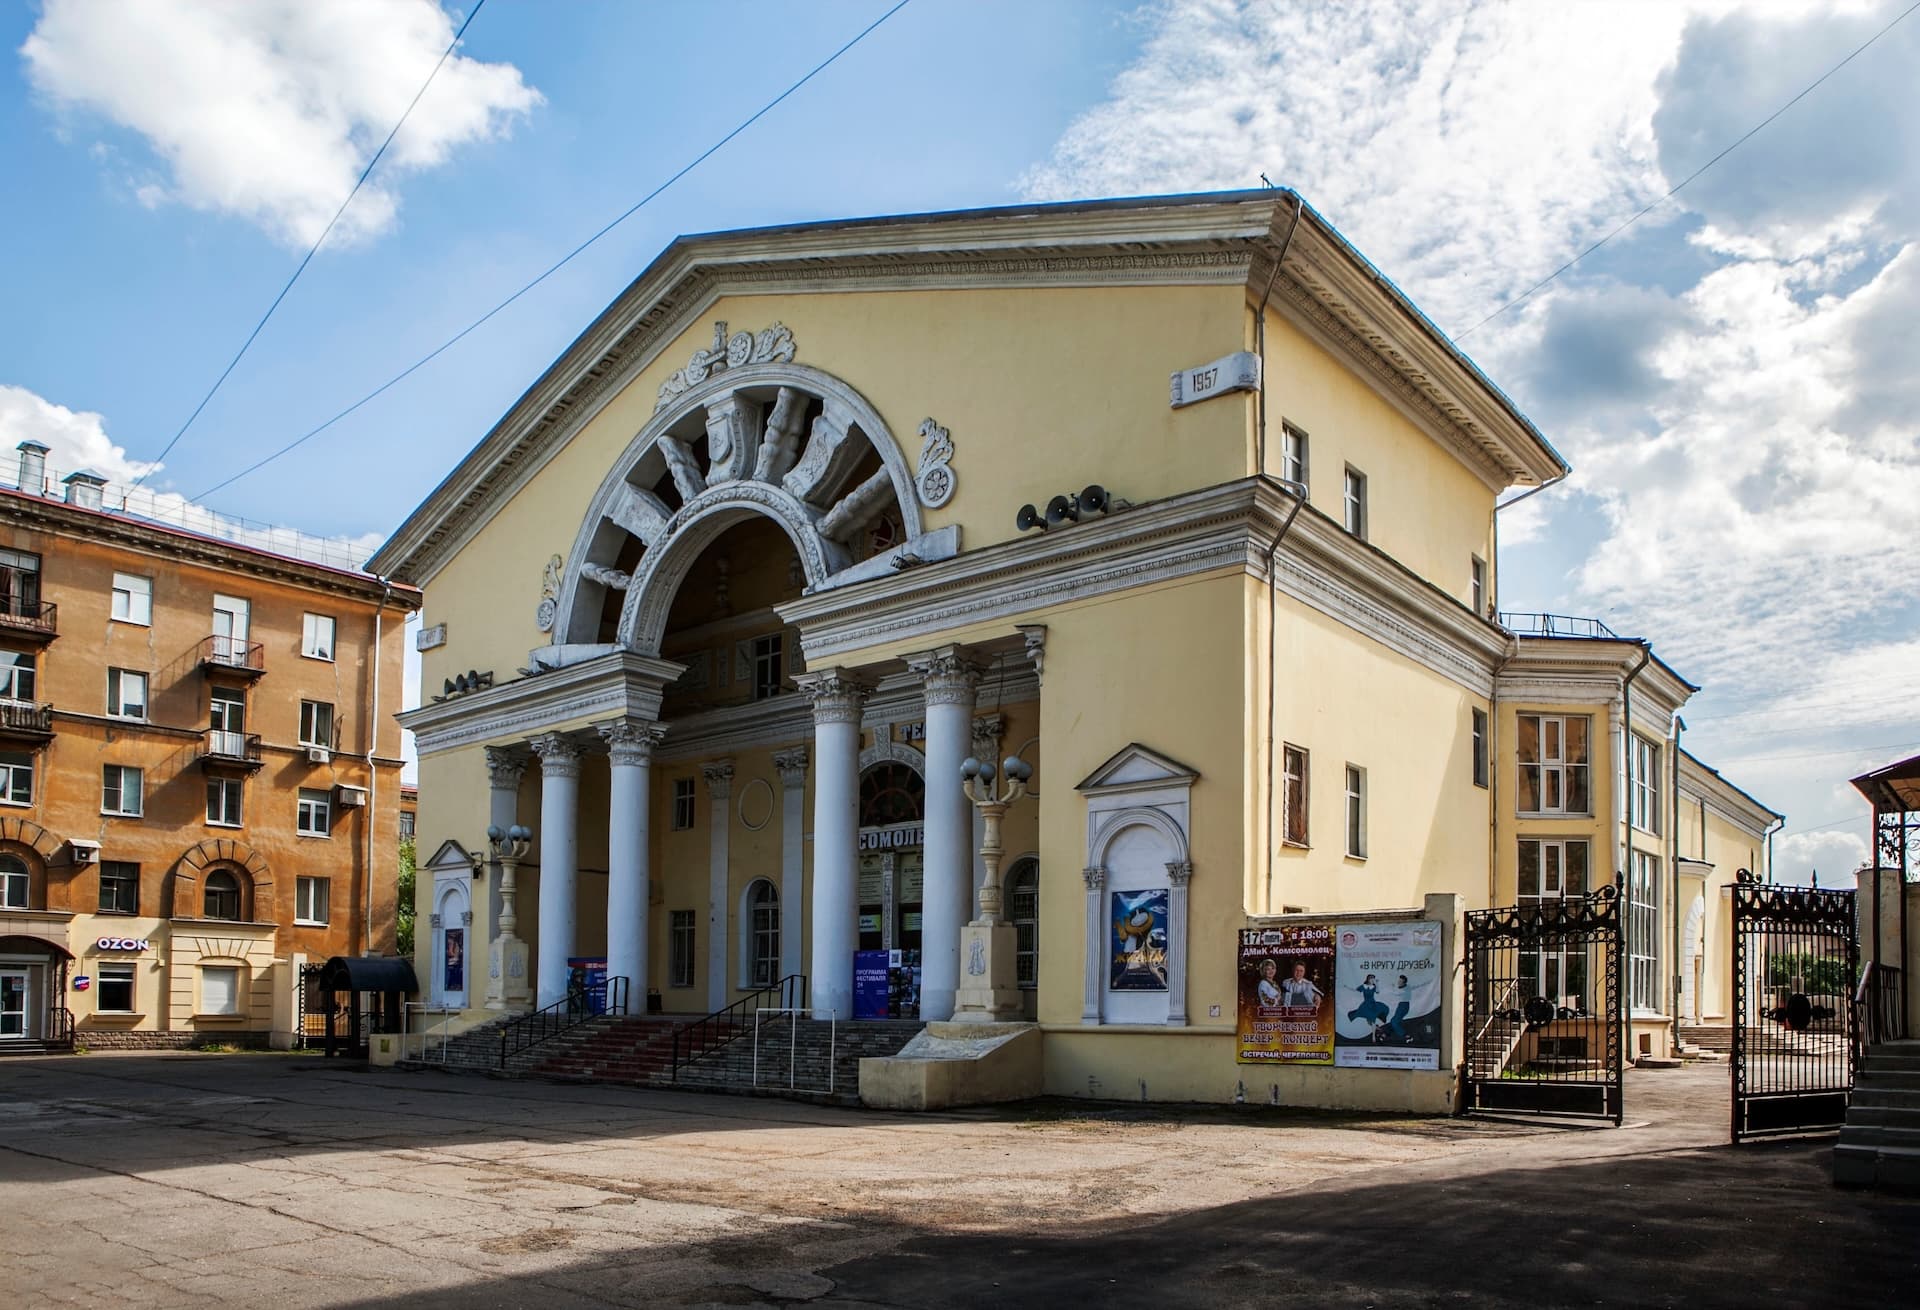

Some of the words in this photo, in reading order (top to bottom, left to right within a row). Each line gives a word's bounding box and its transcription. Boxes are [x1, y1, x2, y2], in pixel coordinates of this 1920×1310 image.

[1192, 367, 1218, 393] 1957
[97, 937, 149, 951] OZON
[1244, 932, 1260, 945] 17
[1300, 930, 1329, 940] 18:00
[1371, 960, 1396, 970] КРУГУ
[1397, 958, 1435, 971] ДРУЗЕЙ»
[1254, 1021, 1317, 1032] ТВОРЧЕСКИЙ
[1243, 1034, 1274, 1044] ВЕЧЕР
[1283, 1034, 1329, 1045] КОНЦЕРТ
